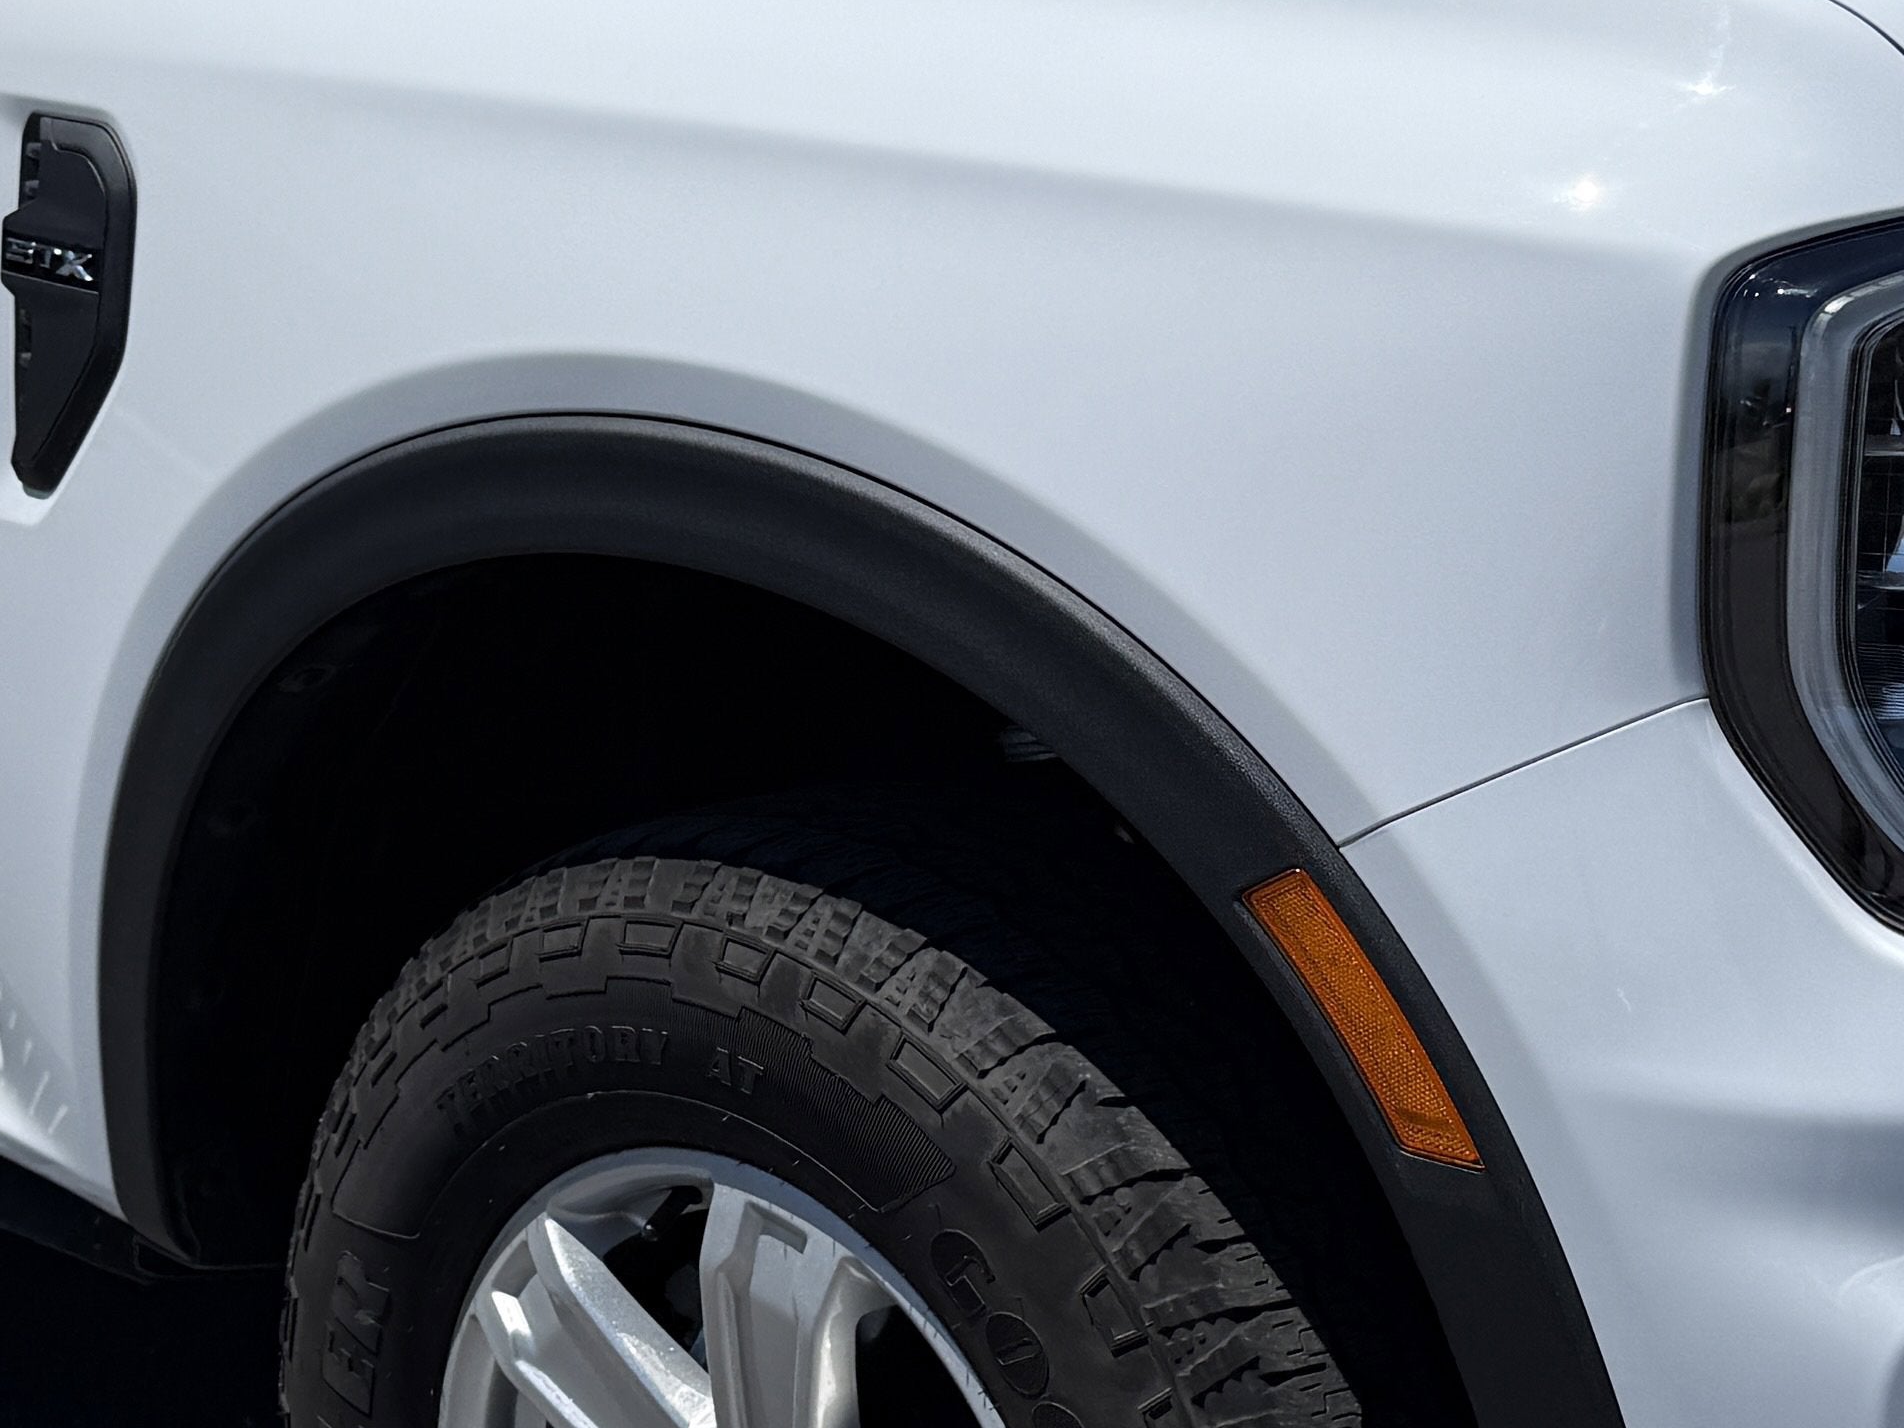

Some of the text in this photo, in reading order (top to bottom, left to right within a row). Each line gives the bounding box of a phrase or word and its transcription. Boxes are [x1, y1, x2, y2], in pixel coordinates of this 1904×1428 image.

[5, 236, 94, 283] STX
[436, 1025, 766, 1138] TERRITORY AT
